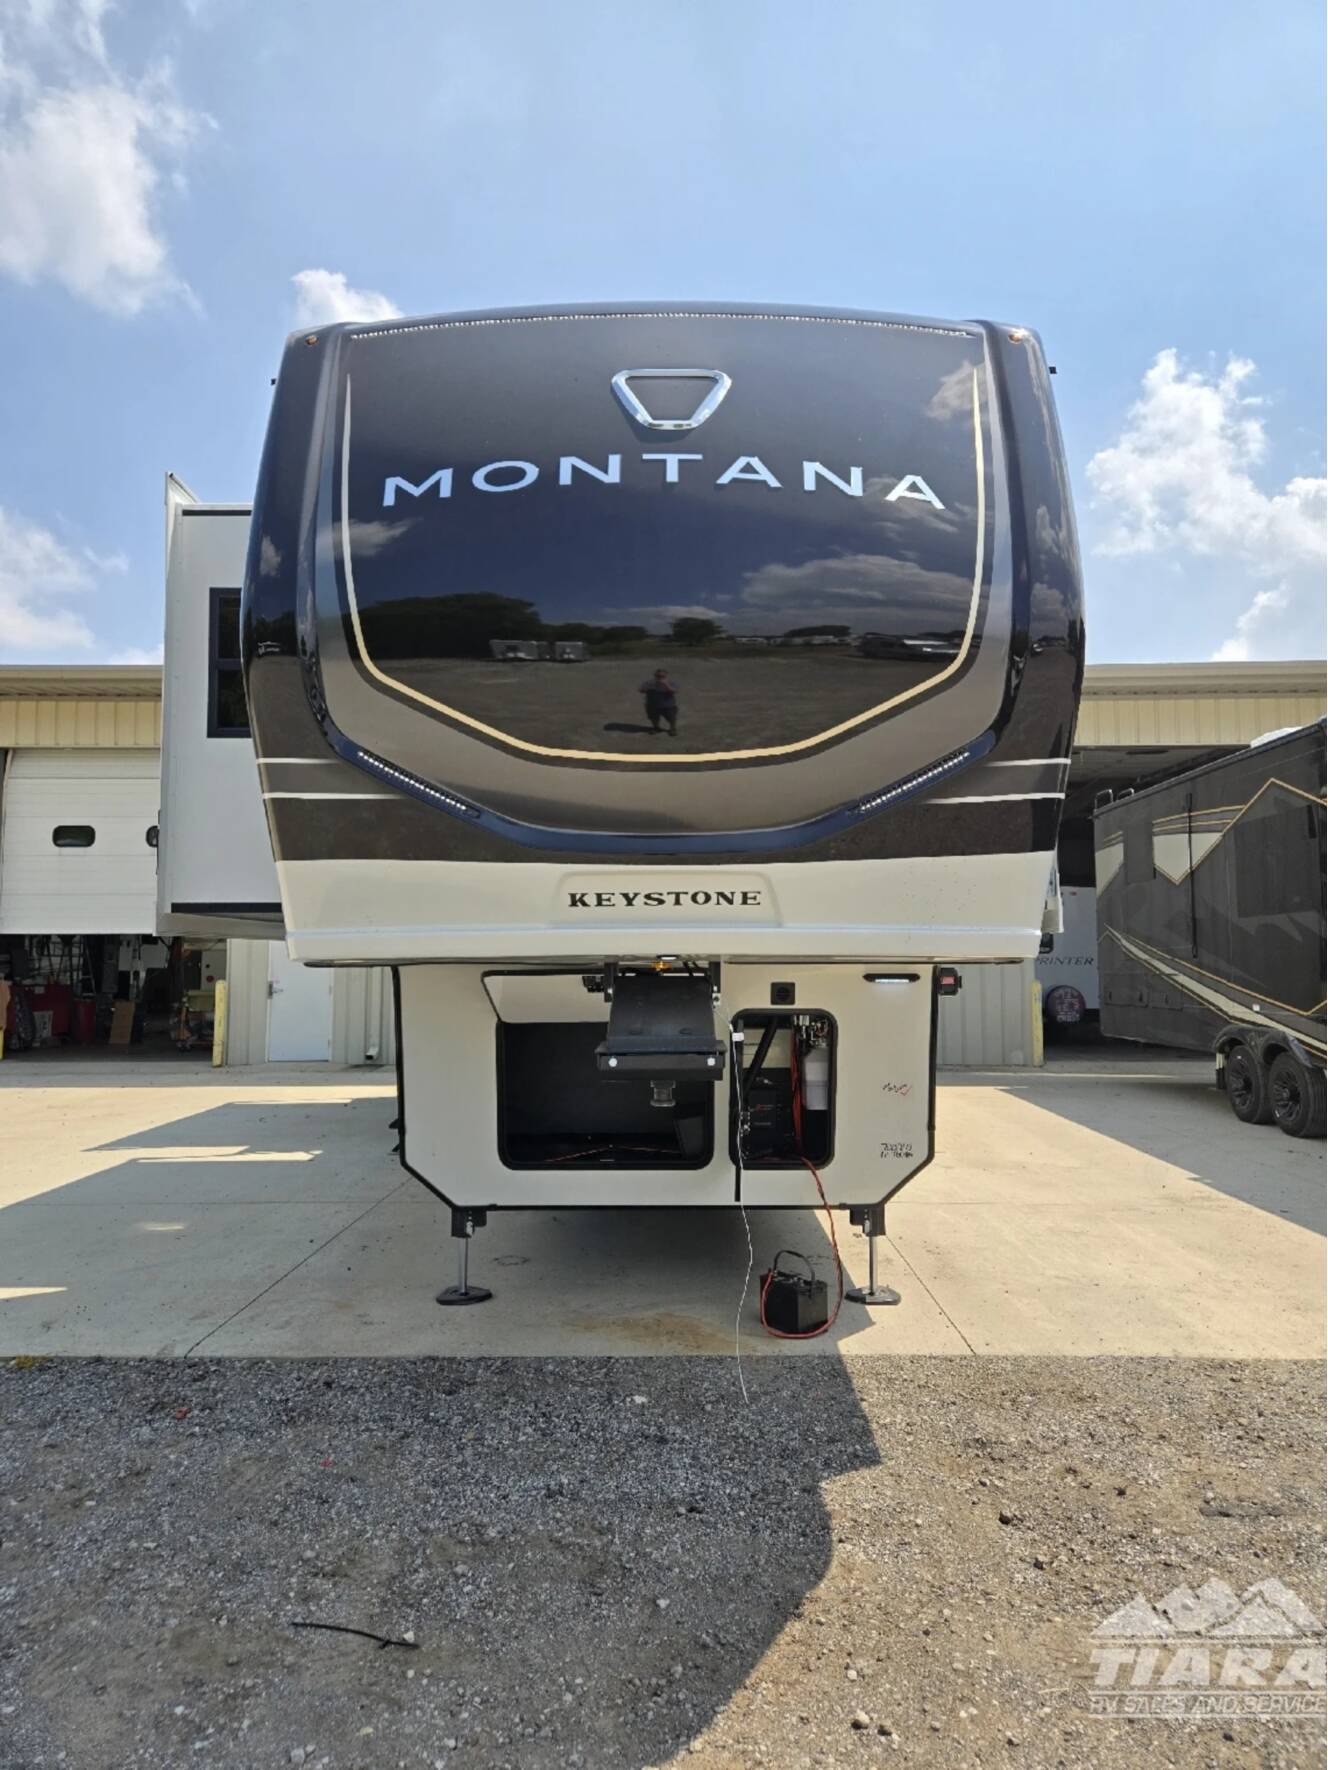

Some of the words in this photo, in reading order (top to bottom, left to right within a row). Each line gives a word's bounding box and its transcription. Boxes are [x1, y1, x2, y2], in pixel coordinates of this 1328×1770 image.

[382, 453, 945, 510] MONTANA
[568, 890, 762, 908] KEYSTONE
[1037, 956, 1095, 966] RINTER
